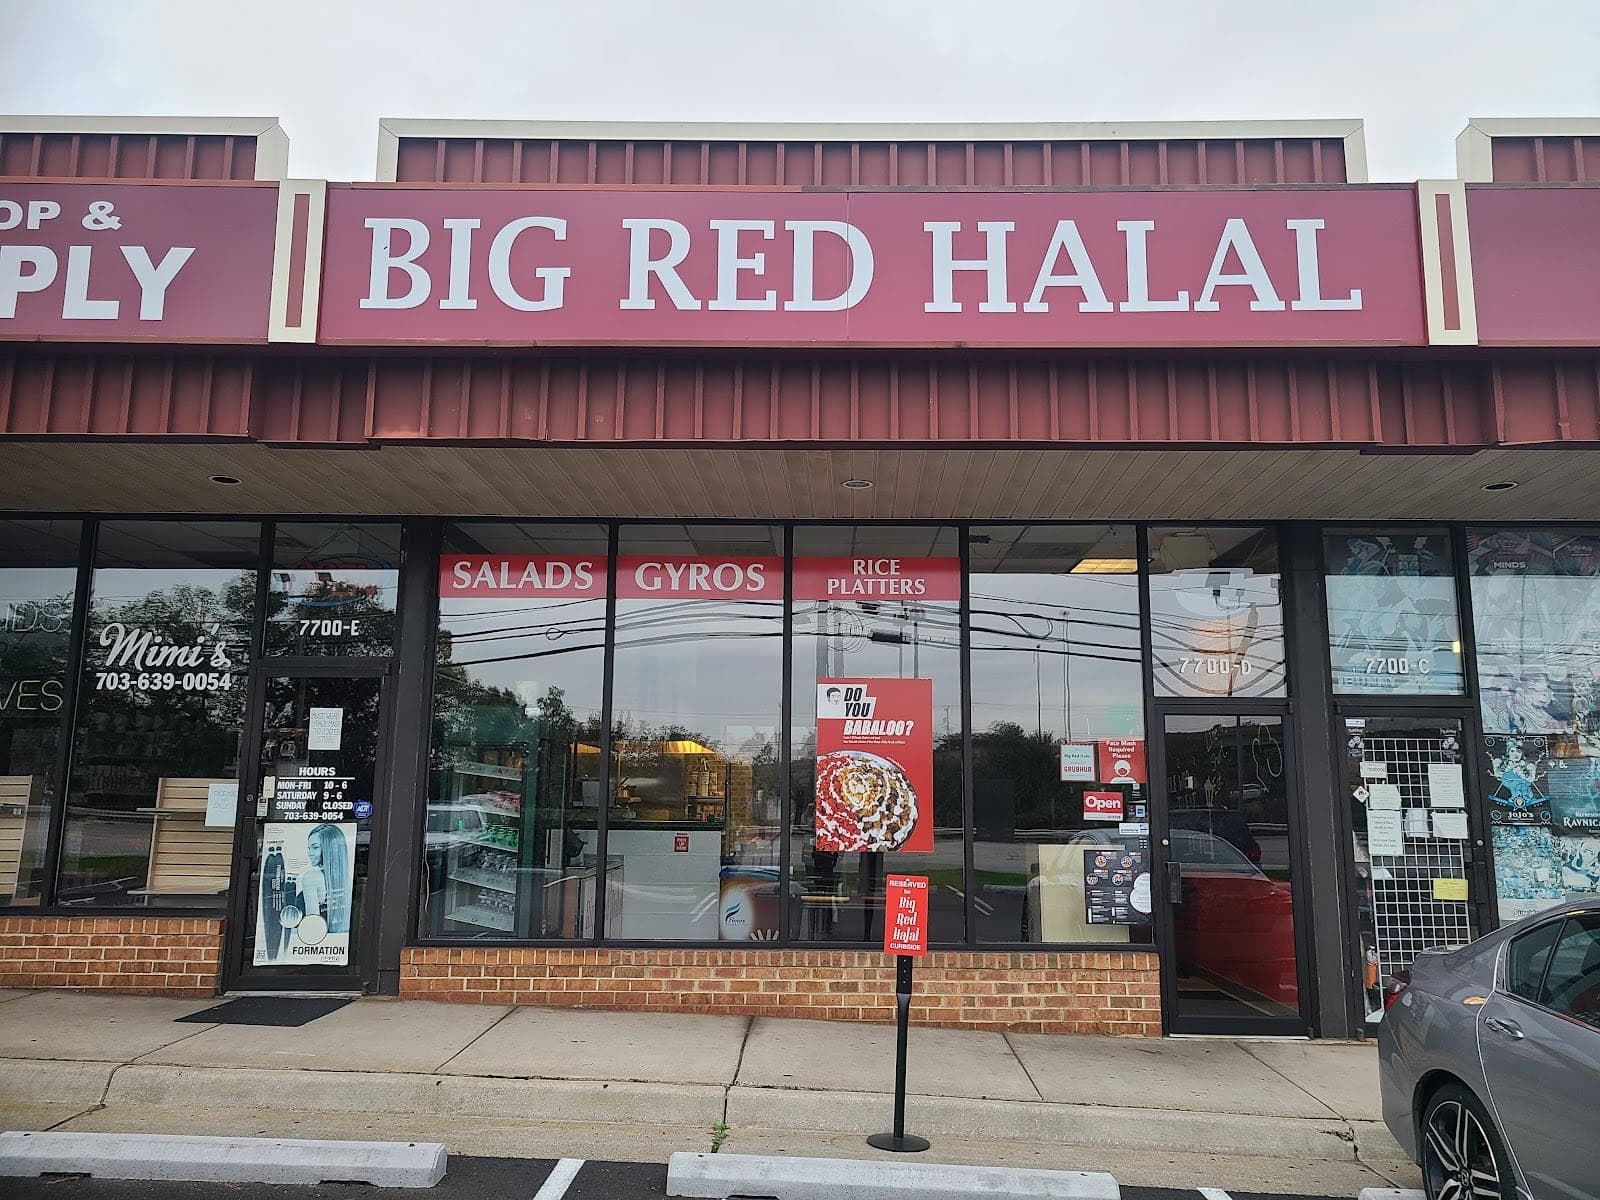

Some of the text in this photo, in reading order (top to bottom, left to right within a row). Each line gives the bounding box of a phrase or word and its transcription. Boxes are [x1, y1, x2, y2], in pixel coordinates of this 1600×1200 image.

[82, 200, 122, 231] &
[360, 216, 1363, 313] BIG RED HALAL
[853, 559, 901, 576] RICE
[1493, 561, 1527, 569] MINDS
[452, 560, 594, 592] SALADS
[634, 561, 767, 593] GYROS
[827, 577, 926, 596] PLATTERS
[300, 620, 360, 636] 7700-E
[100, 622, 232, 671] Mimi's
[1178, 657, 1252, 675] 7700-D
[1365, 657, 1430, 674] 7700-C
[95, 672, 232, 691] 703-639-0054
[844, 687, 863, 702] DO
[845, 702, 871, 717] YOU
[843, 720, 915, 736] BABALOO?
[299, 767, 336, 776] HOURS
[277, 781, 312, 790] MON-FRI
[323, 781, 334, 790] 10
[341, 781, 348, 789] 6
[276, 791, 317, 800] SATURDAY
[323, 791, 329, 800] 9
[336, 791, 343, 800] 6
[1085, 795, 1121, 811] Open
[275, 801, 353, 810] SUNDAY CLOSED
[284, 811, 344, 820] 703-639-0054
[1563, 817, 1600, 829] RAVNIC
[889, 880, 927, 889] RESERVED
[899, 896, 916, 914] Big
[896, 912, 918, 927] Red
[893, 927, 920, 943] Halal
[292, 946, 345, 956] FORMATION
[889, 943, 922, 951] CURBSIDE
